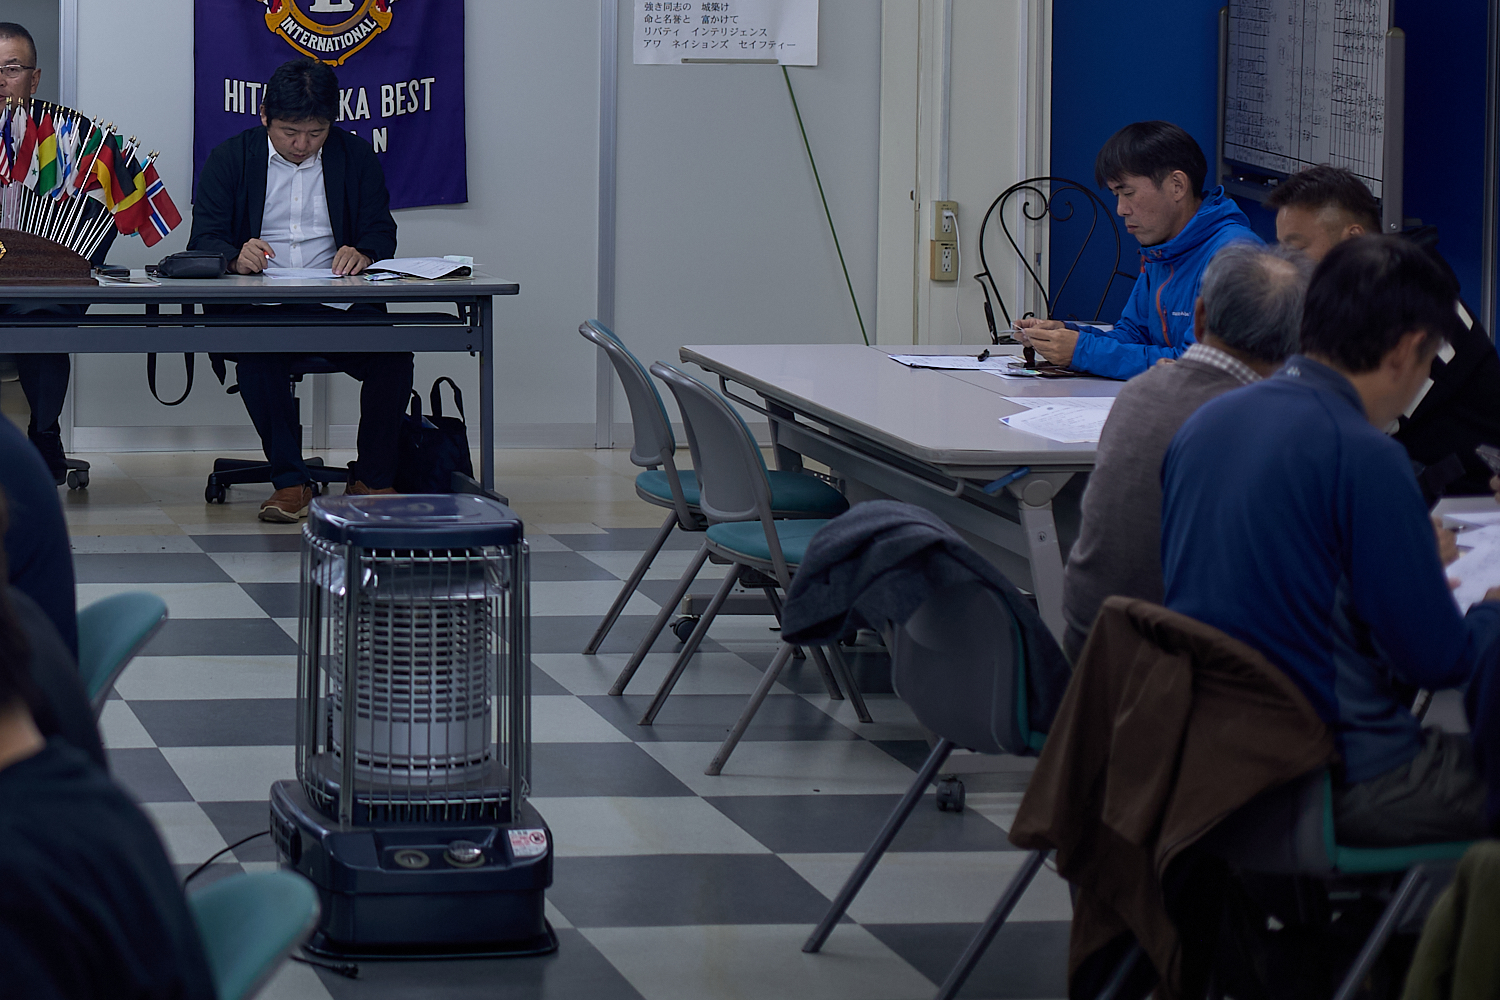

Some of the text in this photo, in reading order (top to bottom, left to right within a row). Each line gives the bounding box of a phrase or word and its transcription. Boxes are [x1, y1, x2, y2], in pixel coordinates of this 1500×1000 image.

[645, 2, 729, 12] 強き同志の 城築け
[645, 14, 738, 24] 命と名誉と 富かけて
[280, 16, 377, 52] INTERNATIONAL
[645, 27, 767, 36] リバティ インテリジェンス
[644, 40, 795, 49] アワ ネイションズ セイフティー
[381, 78, 435, 117] BEST
